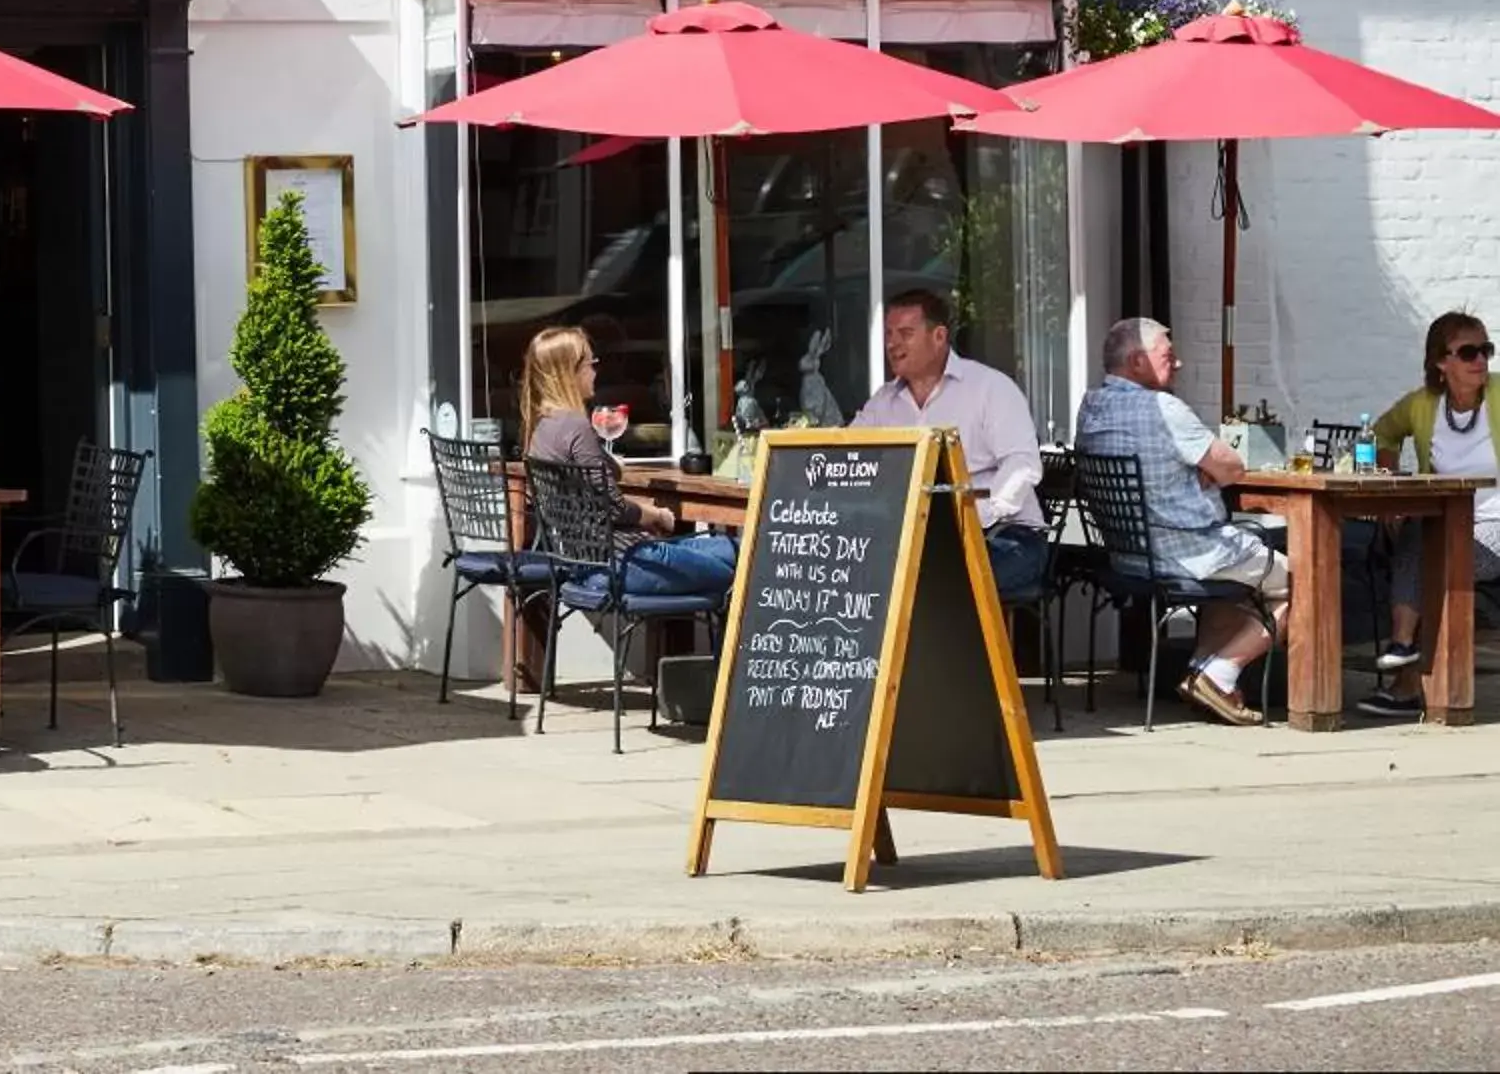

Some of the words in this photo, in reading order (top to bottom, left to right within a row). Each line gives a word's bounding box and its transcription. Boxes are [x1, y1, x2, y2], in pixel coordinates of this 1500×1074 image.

[825, 463, 848, 478] RED
[849, 461, 879, 478] LION
[770, 499, 839, 526] Celebrate
[768, 530, 832, 559] FATHER'S
[835, 535, 872, 563] DAY
[775, 561, 803, 580] WITH
[808, 564, 827, 583] US
[831, 565, 851, 583] ON
[758, 587, 811, 612] SUNDAY
[837, 591, 881, 621] JUNE
[750, 632, 784, 653] EVERY
[788, 633, 829, 658] DINING
[834, 635, 860, 659] DAD
[747, 657, 800, 681] RECEIVES
[802, 663, 810, 678] A
[746, 685, 780, 708] PINT
[781, 685, 798, 706] OF
[801, 684, 824, 710] RED
[823, 684, 853, 711] MIST
